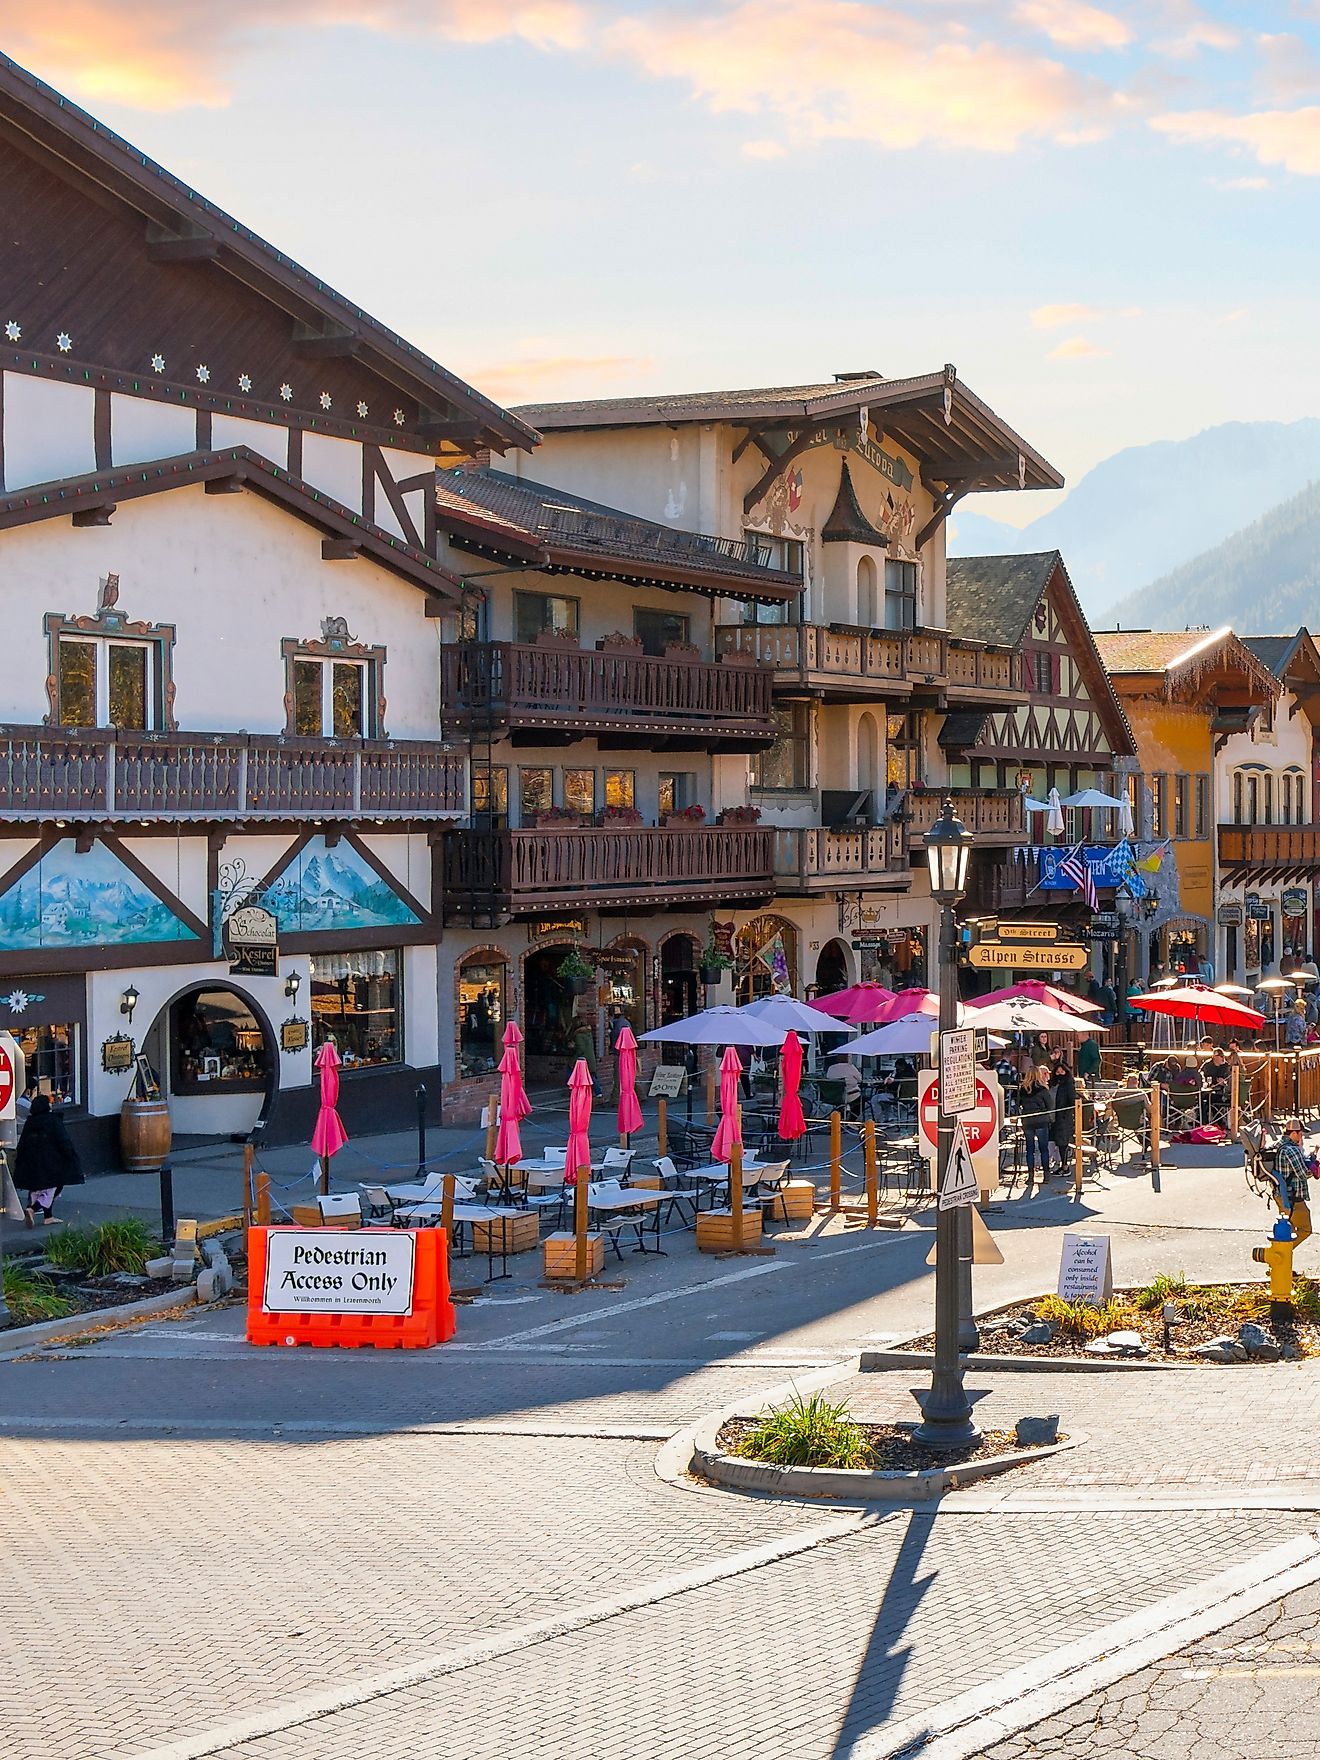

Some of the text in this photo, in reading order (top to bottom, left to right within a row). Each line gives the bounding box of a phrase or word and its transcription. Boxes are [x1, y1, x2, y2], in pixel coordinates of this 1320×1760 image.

[1019, 929, 1051, 937] Street
[241, 946, 275, 961] Kestrel
[980, 949, 1075, 964] Alpen Strasse
[975, 1037, 984, 1051] AY
[944, 1052, 973, 1066] REGULATIONS
[953, 1069, 972, 1077] PARKING
[293, 1245, 387, 1265] Pedestrian
[1073, 1248, 1098, 1257] Alcohol
[280, 1270, 398, 1296] Access Only
[1065, 1275, 1079, 1284] only
[293, 1295, 333, 1303] Willkommen
